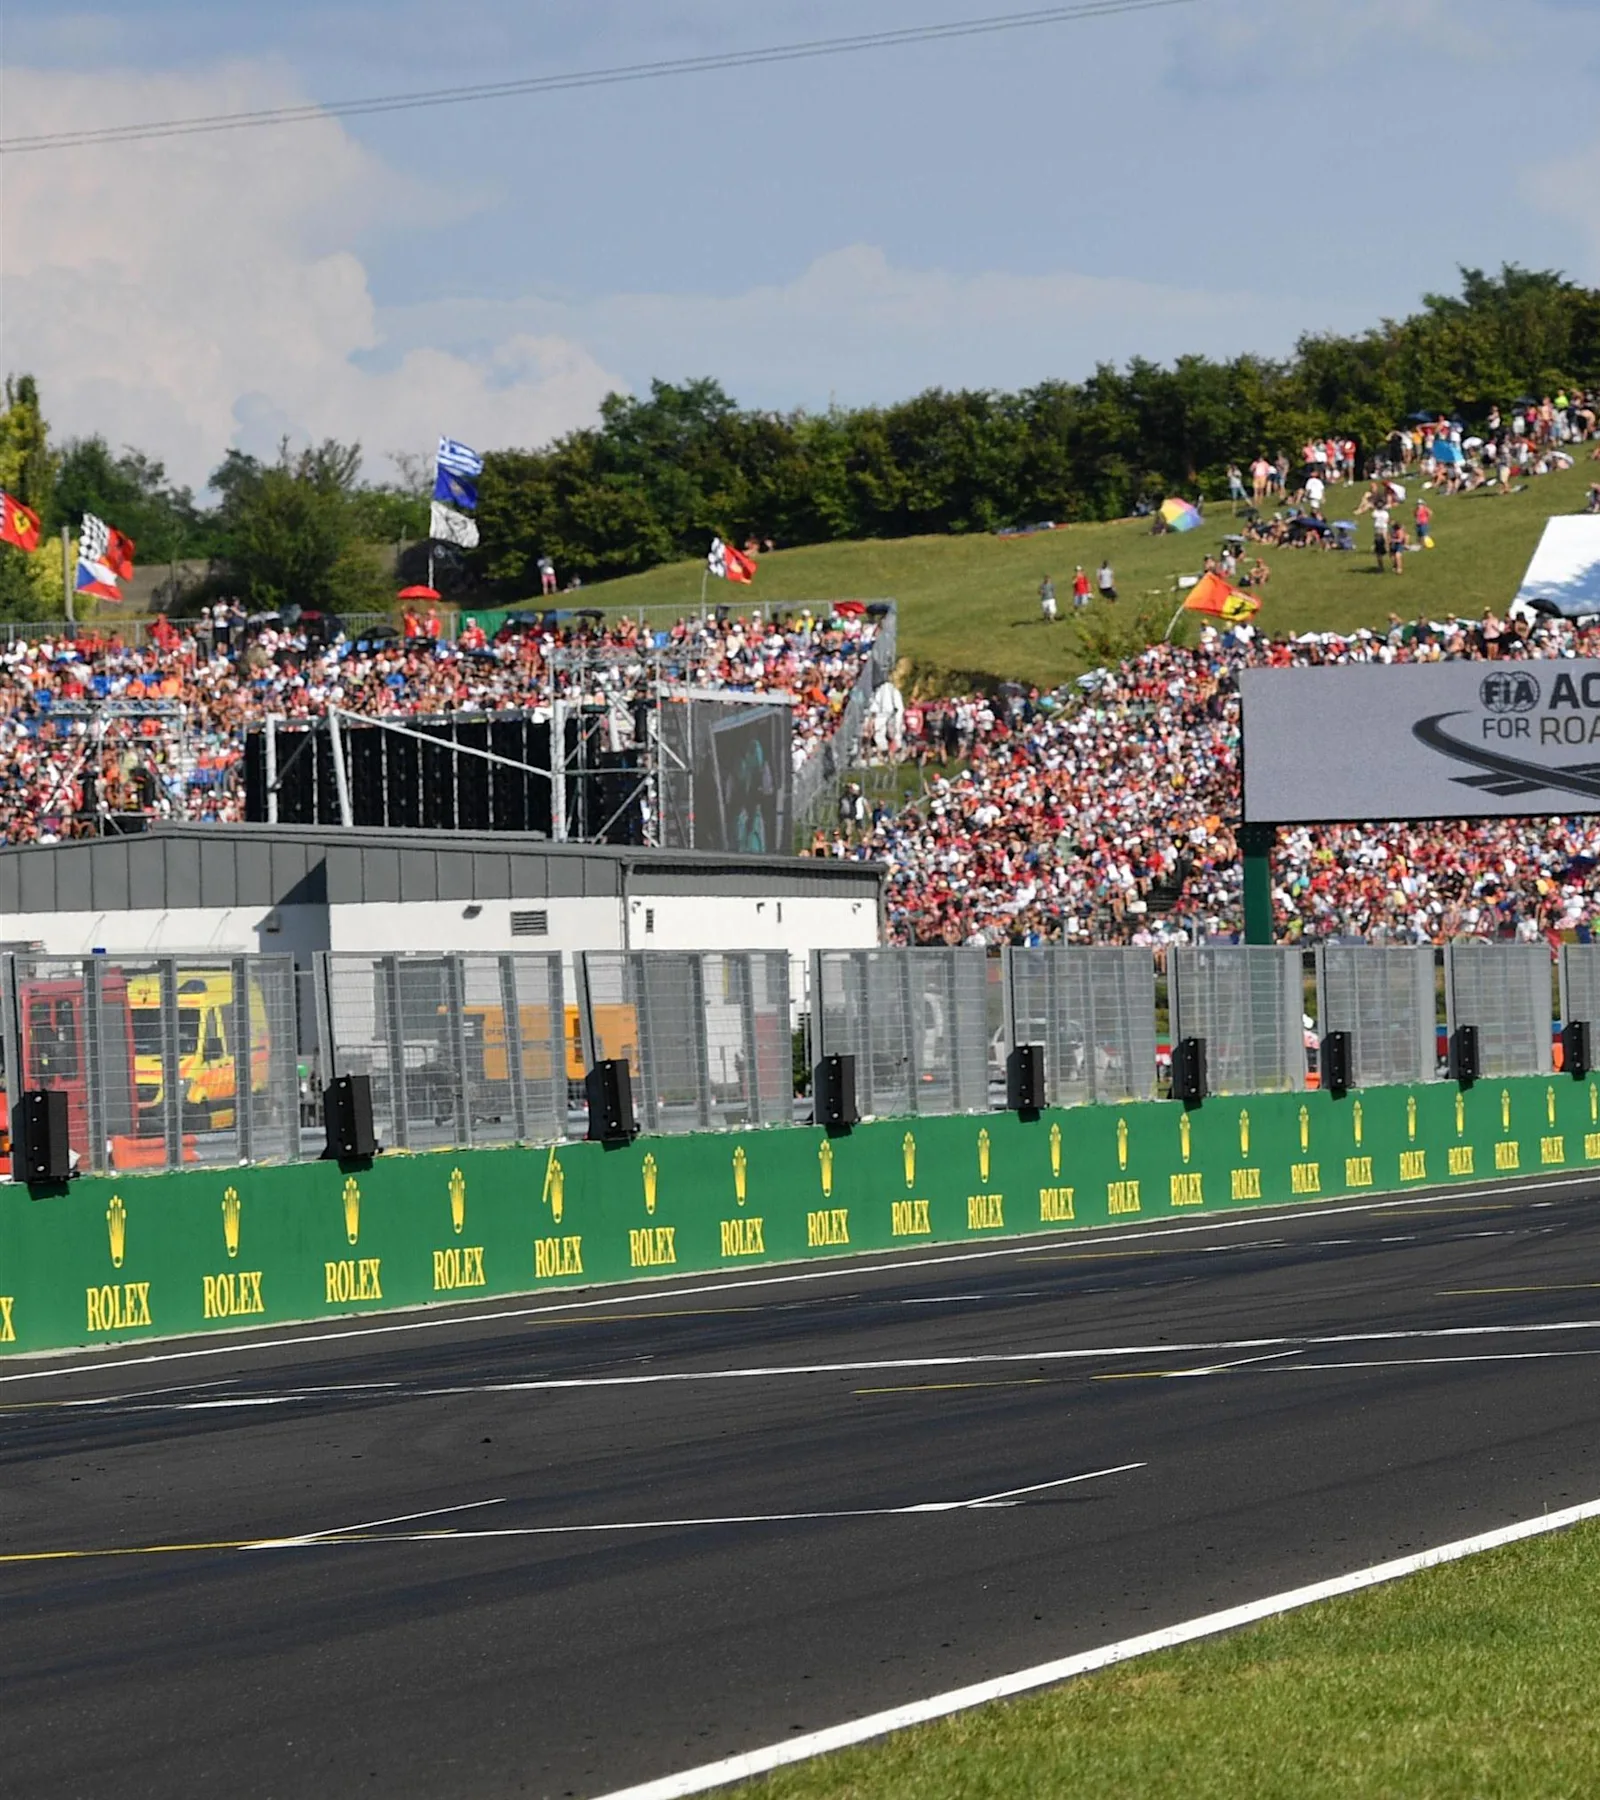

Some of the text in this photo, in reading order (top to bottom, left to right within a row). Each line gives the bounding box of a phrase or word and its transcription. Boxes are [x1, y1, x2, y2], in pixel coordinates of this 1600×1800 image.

[1482, 717, 1532, 739] FOR
[1108, 1180, 1141, 1214] ROLEX
[1171, 1173, 1203, 1205] ROLEX
[1231, 1169, 1262, 1199] ROLEX
[892, 1200, 931, 1235] ROLEX
[967, 1195, 1003, 1229] ROLEX
[1040, 1188, 1075, 1221] ROLEX
[720, 1218, 764, 1256] ROLEX
[808, 1209, 849, 1246] ROLEX
[535, 1236, 583, 1278] ROLEX
[630, 1227, 676, 1267] ROLEX
[326, 1258, 382, 1303] ROLEX
[433, 1247, 485, 1291] ROLEX
[86, 1282, 152, 1332] ROLEX
[203, 1271, 264, 1318] ROLEX
